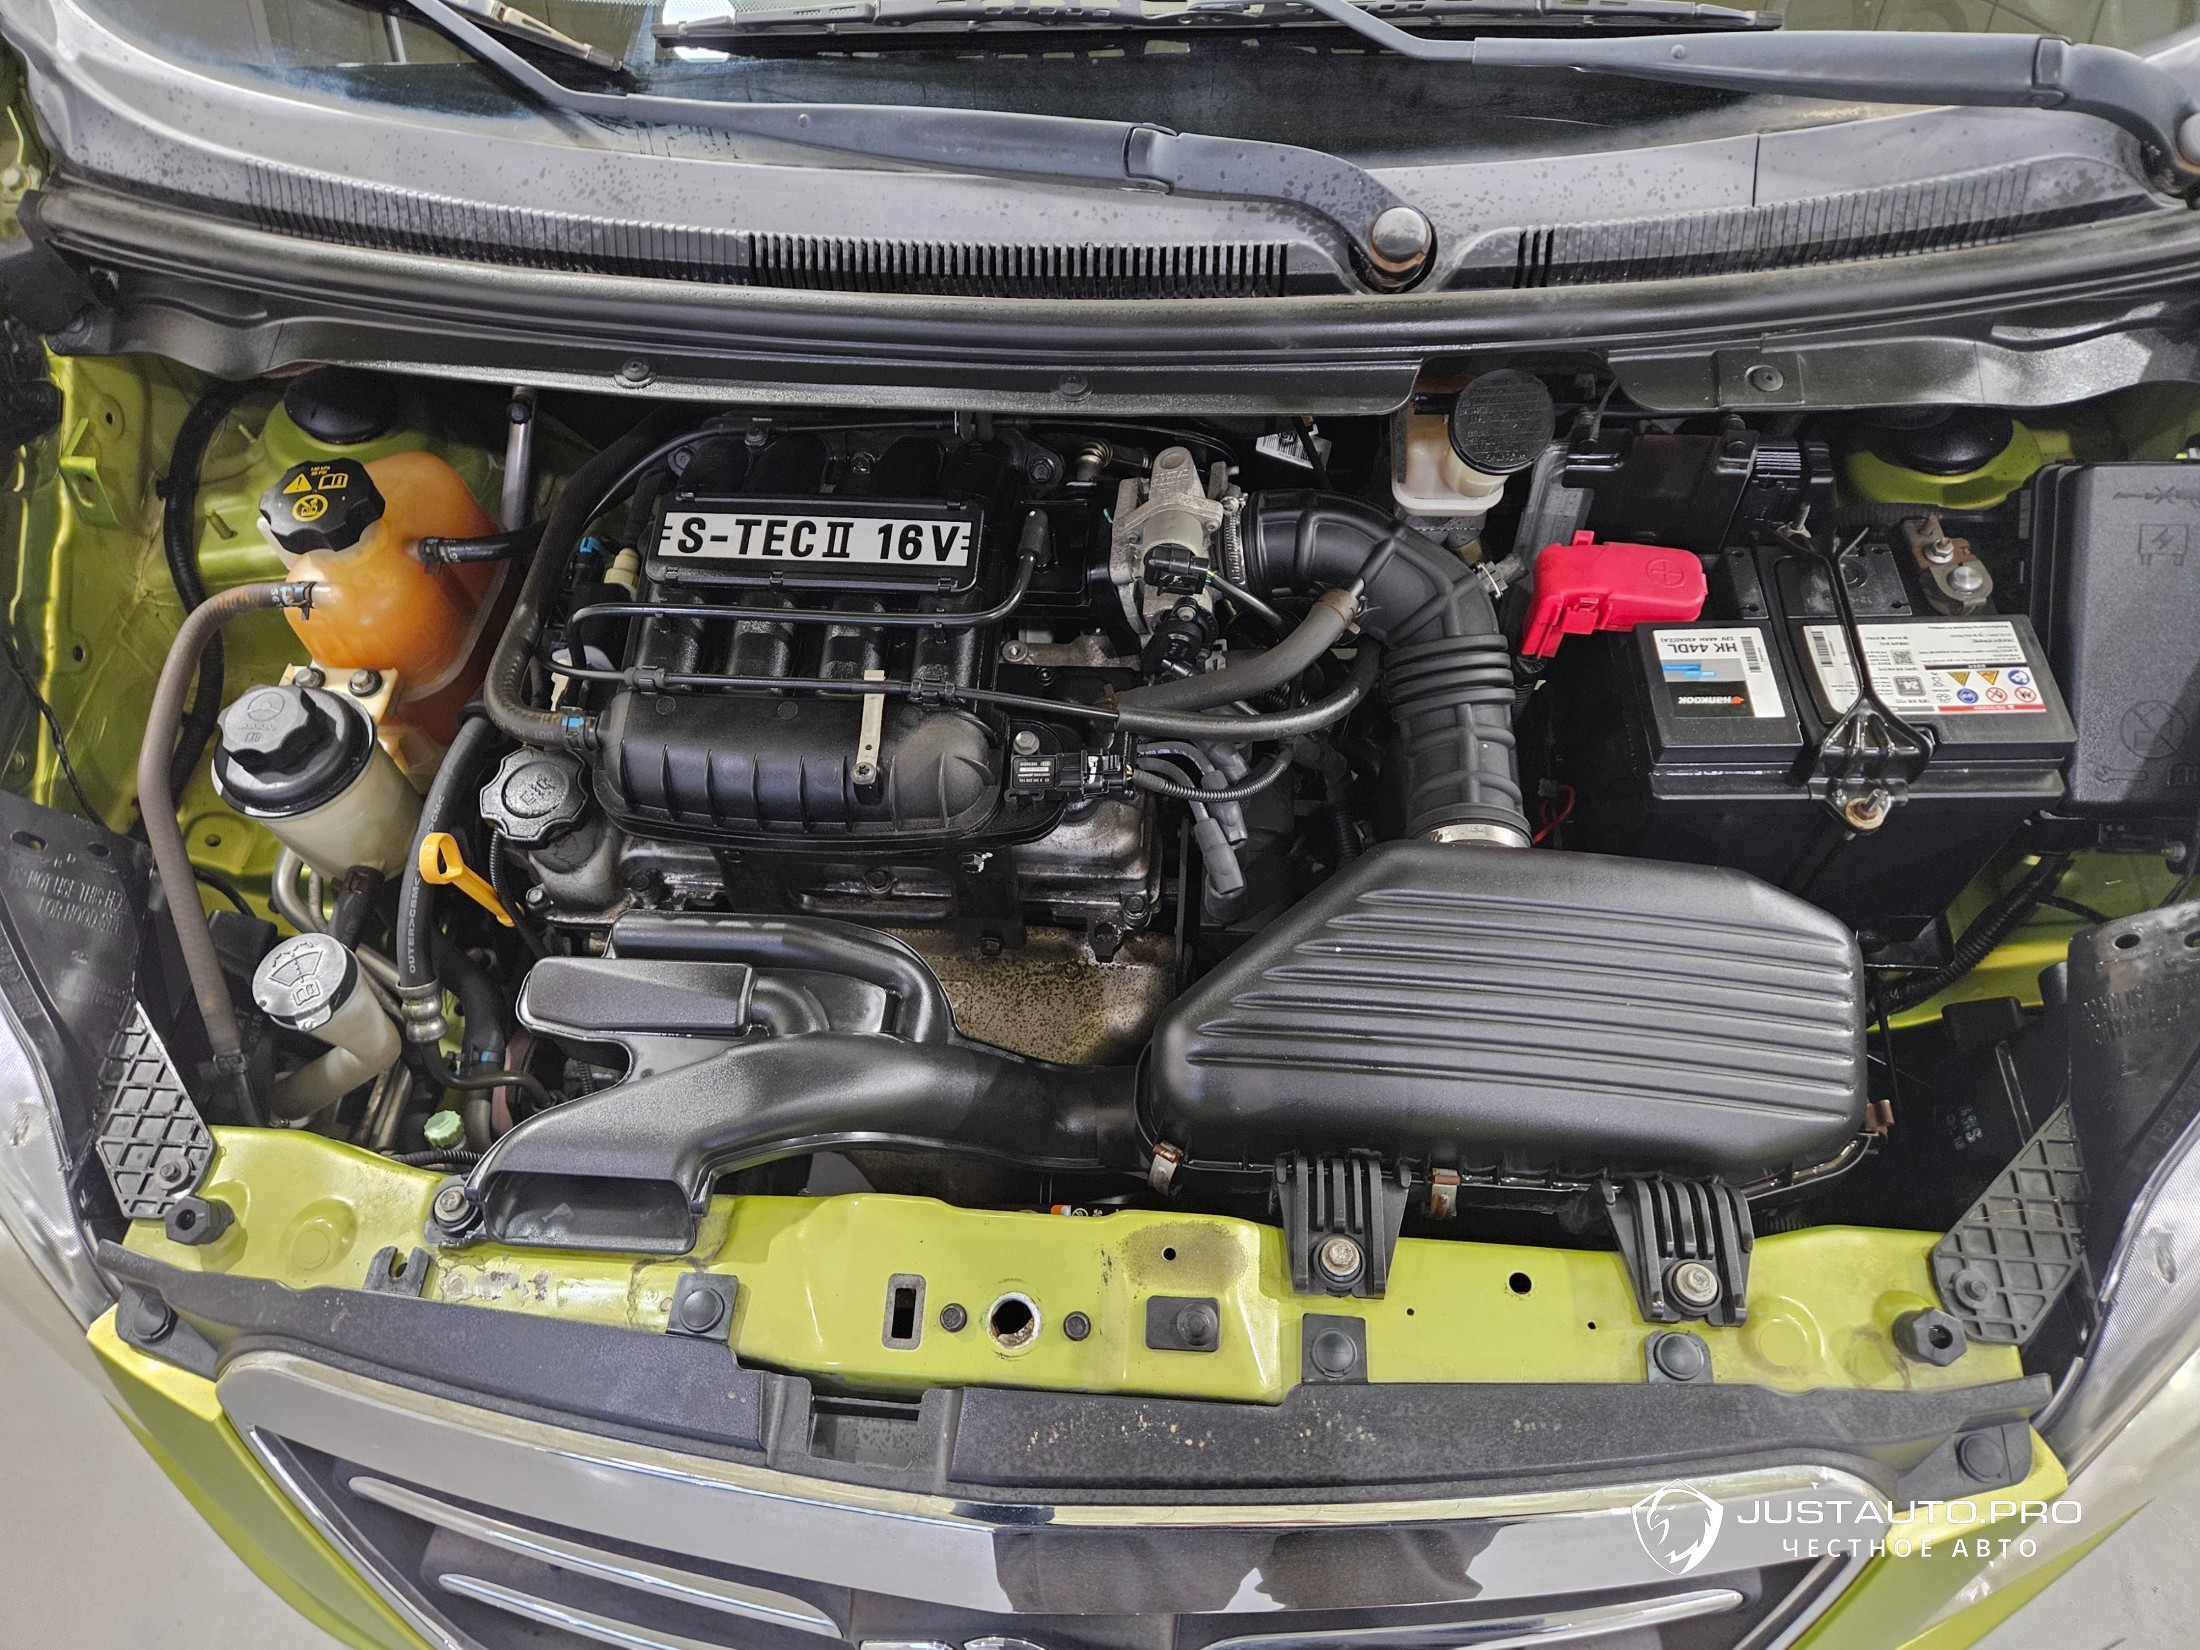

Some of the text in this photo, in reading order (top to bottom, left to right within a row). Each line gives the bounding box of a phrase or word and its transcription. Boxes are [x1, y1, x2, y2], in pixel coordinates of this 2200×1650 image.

[877, 523, 960, 562] 16V
[1667, 643, 1738, 653] HK 44DL
